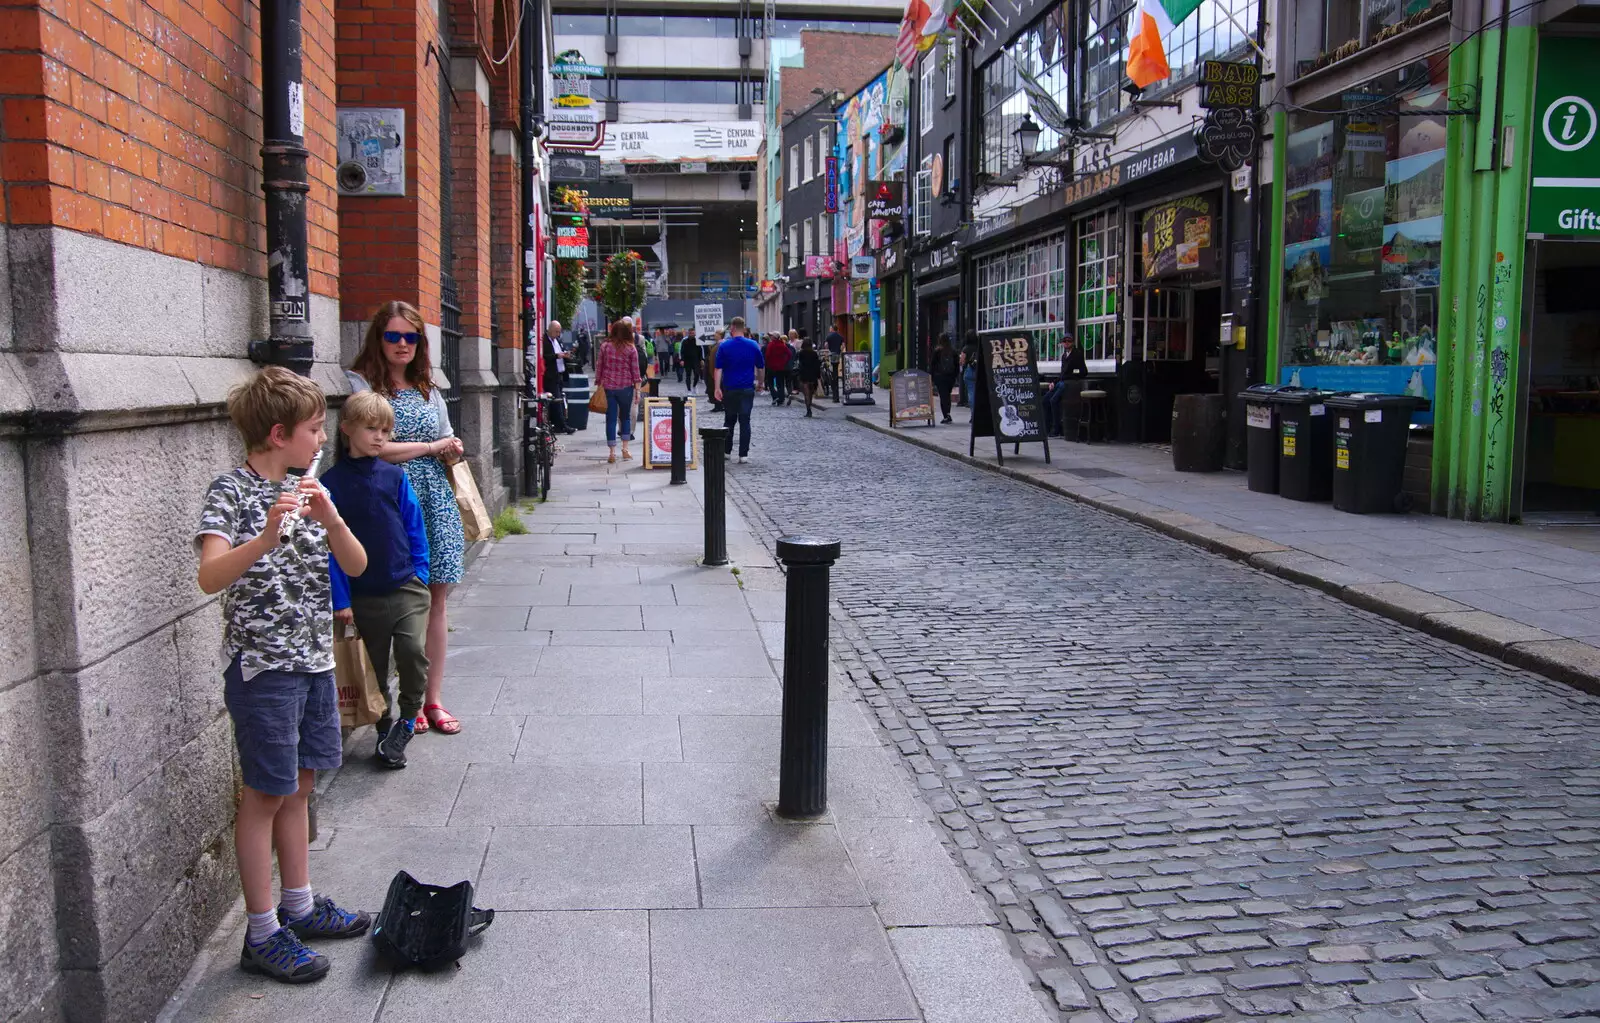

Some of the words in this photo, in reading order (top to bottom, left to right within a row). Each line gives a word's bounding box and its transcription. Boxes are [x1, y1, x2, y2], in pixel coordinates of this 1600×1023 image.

[1206, 62, 1258, 84] BAD
[1208, 85, 1253, 106] ASS
[551, 124, 594, 132] DOUGHBOYS
[727, 128, 756, 138] CENTRAL
[621, 131, 649, 141] CENTRAL
[621, 141, 641, 150] PLAZA
[728, 138, 747, 148] PLAZA
[1126, 147, 1176, 180] TEMPLEBAR
[828, 160, 837, 209] TATTOO
[1064, 164, 1121, 205] BADASS
[989, 338, 1029, 354] BAD
[991, 352, 1028, 369] ASS
[1003, 377, 1033, 385] FOOD
[1025, 421, 1039, 430] LIVE
[1019, 428, 1040, 437] SPORT
